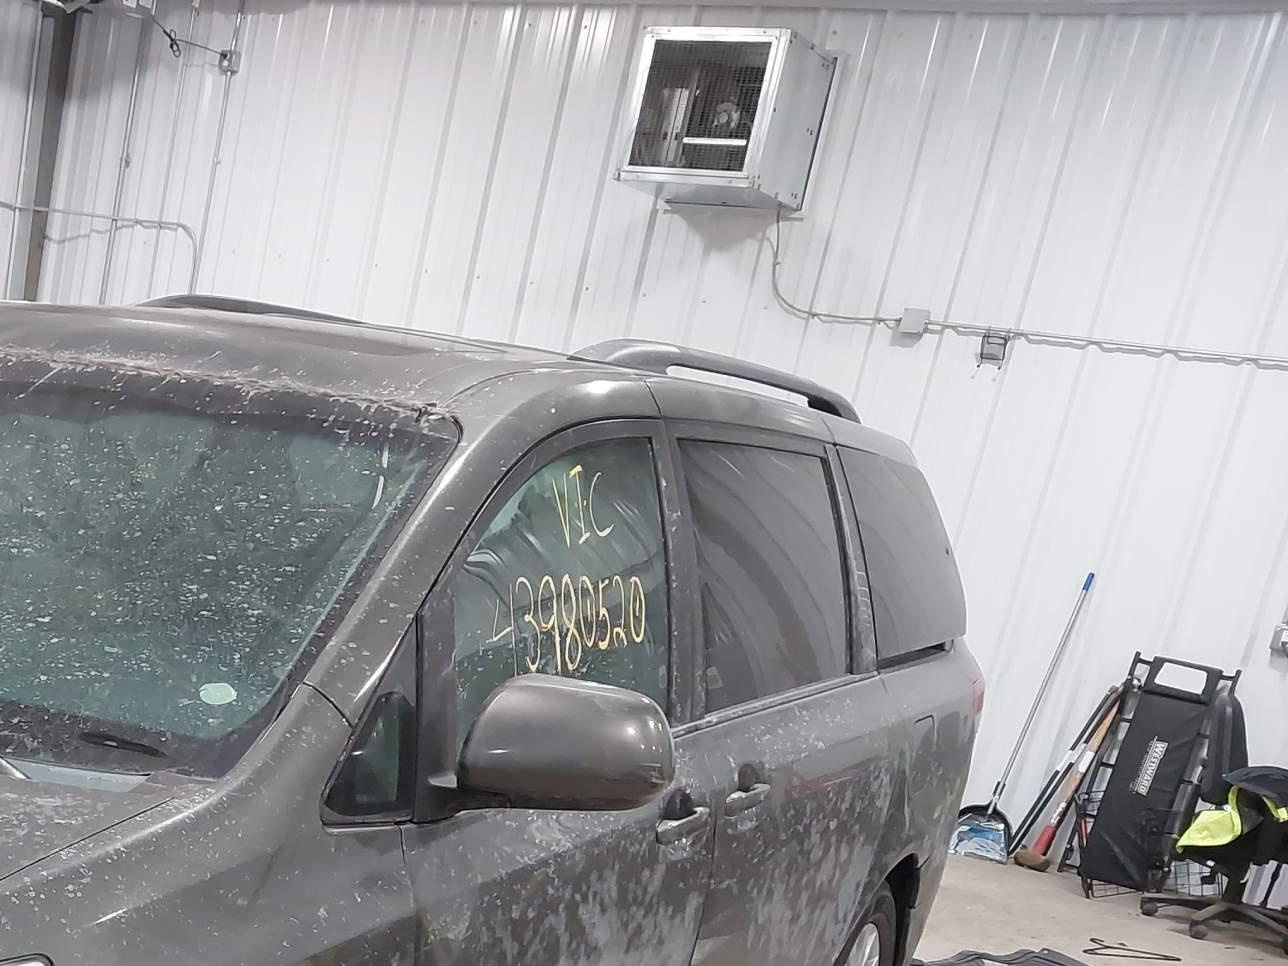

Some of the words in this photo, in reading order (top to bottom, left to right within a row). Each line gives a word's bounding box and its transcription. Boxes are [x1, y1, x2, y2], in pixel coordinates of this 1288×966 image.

[553, 465, 614, 549] VIC
[486, 573, 645, 677] 43980520
[1138, 743, 1165, 793] WESTWARD
